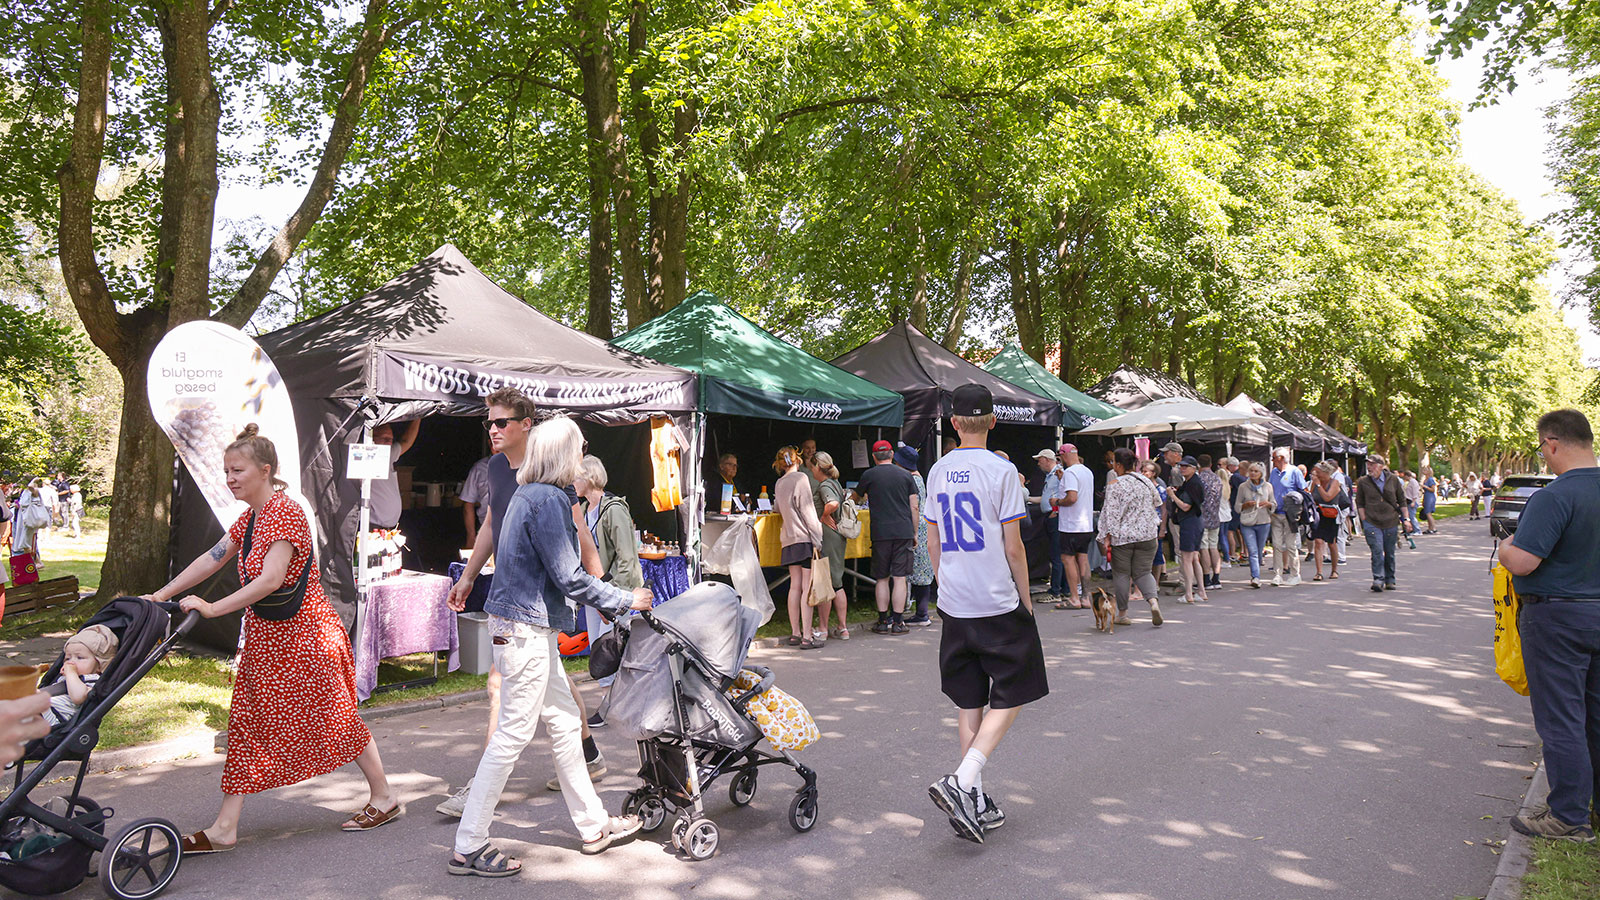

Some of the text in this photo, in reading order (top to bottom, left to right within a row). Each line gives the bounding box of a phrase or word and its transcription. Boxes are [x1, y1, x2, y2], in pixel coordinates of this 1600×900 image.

[401, 359, 471, 395] WOOD
[557, 380, 627, 405] DANISH
[627, 380, 684, 405] DESIGN
[787, 398, 843, 421] FOREVER
[946, 470, 971, 484] VOSS
[701, 698, 745, 742] BabyTrold
